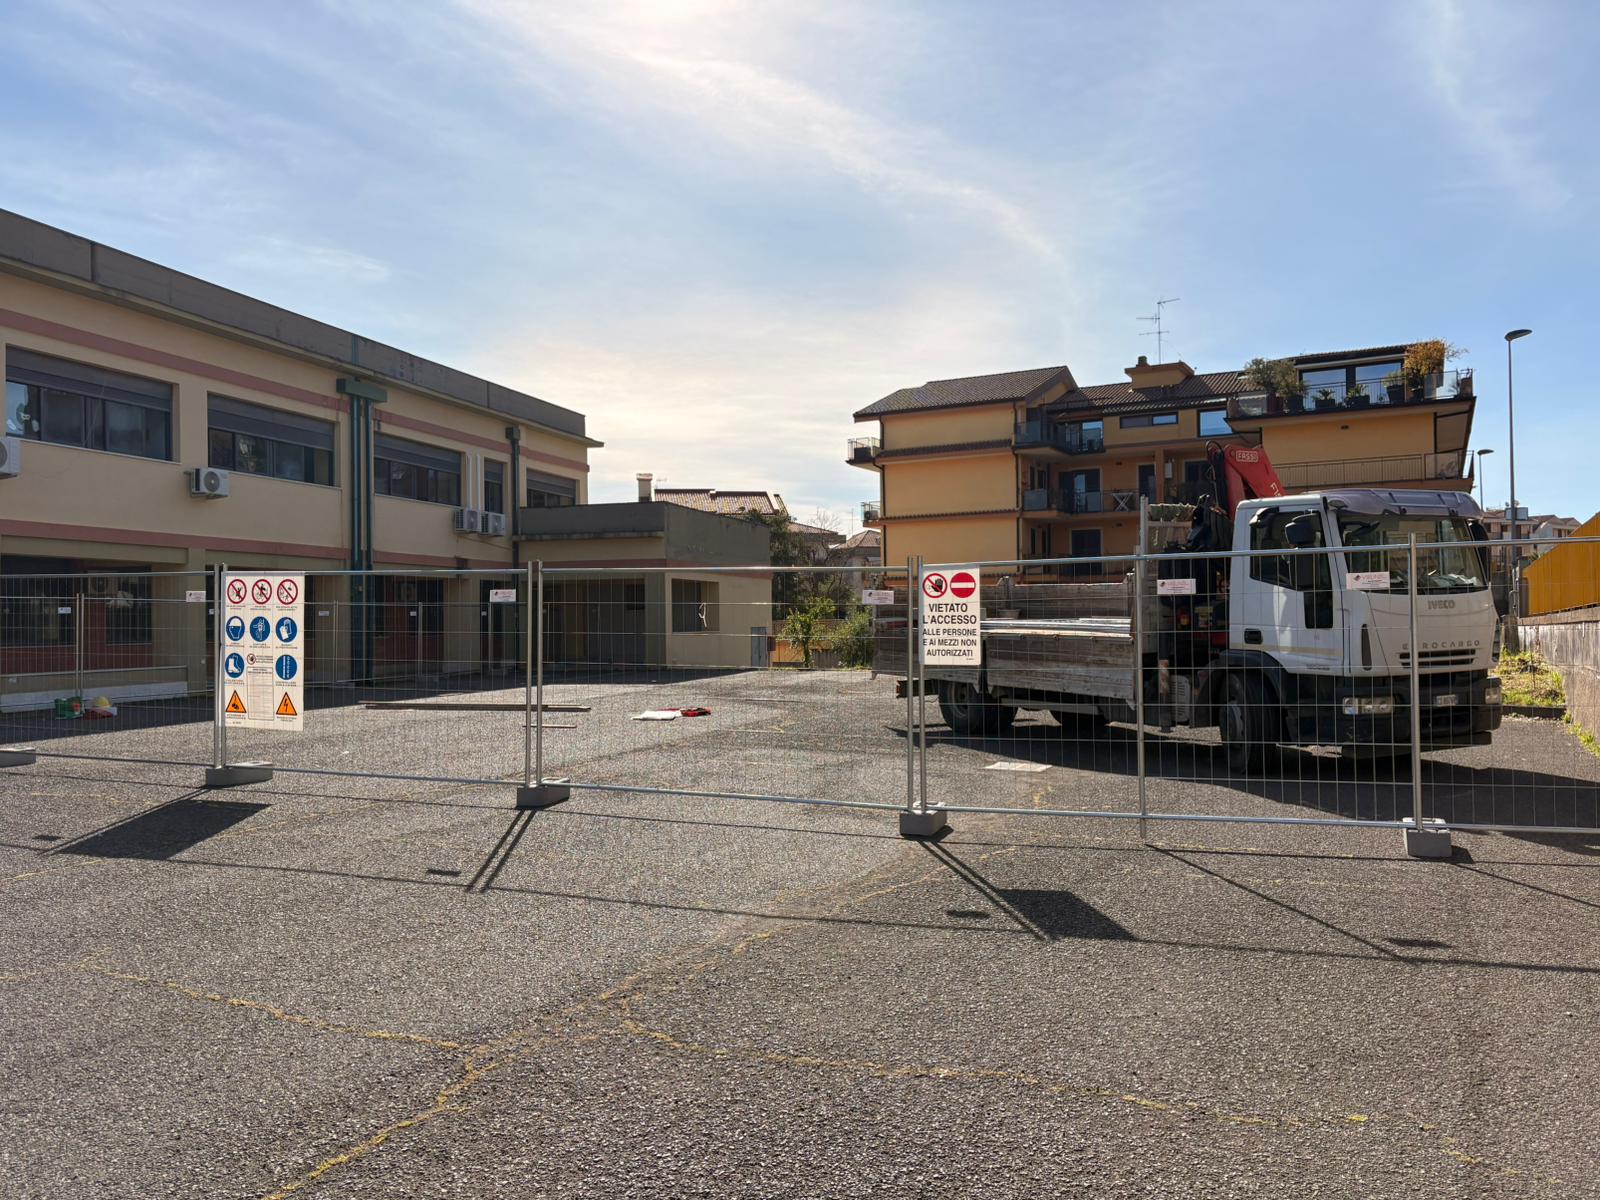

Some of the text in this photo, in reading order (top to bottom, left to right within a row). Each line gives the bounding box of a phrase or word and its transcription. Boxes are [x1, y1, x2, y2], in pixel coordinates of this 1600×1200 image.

[928, 603, 968, 613] VIETATO
[1428, 600, 1455, 609] IVECO
[922, 614, 977, 624] L'ACCESSO
[922, 628, 977, 636] ALLE PERSONE
[1402, 640, 1480, 650] EROCARGO
